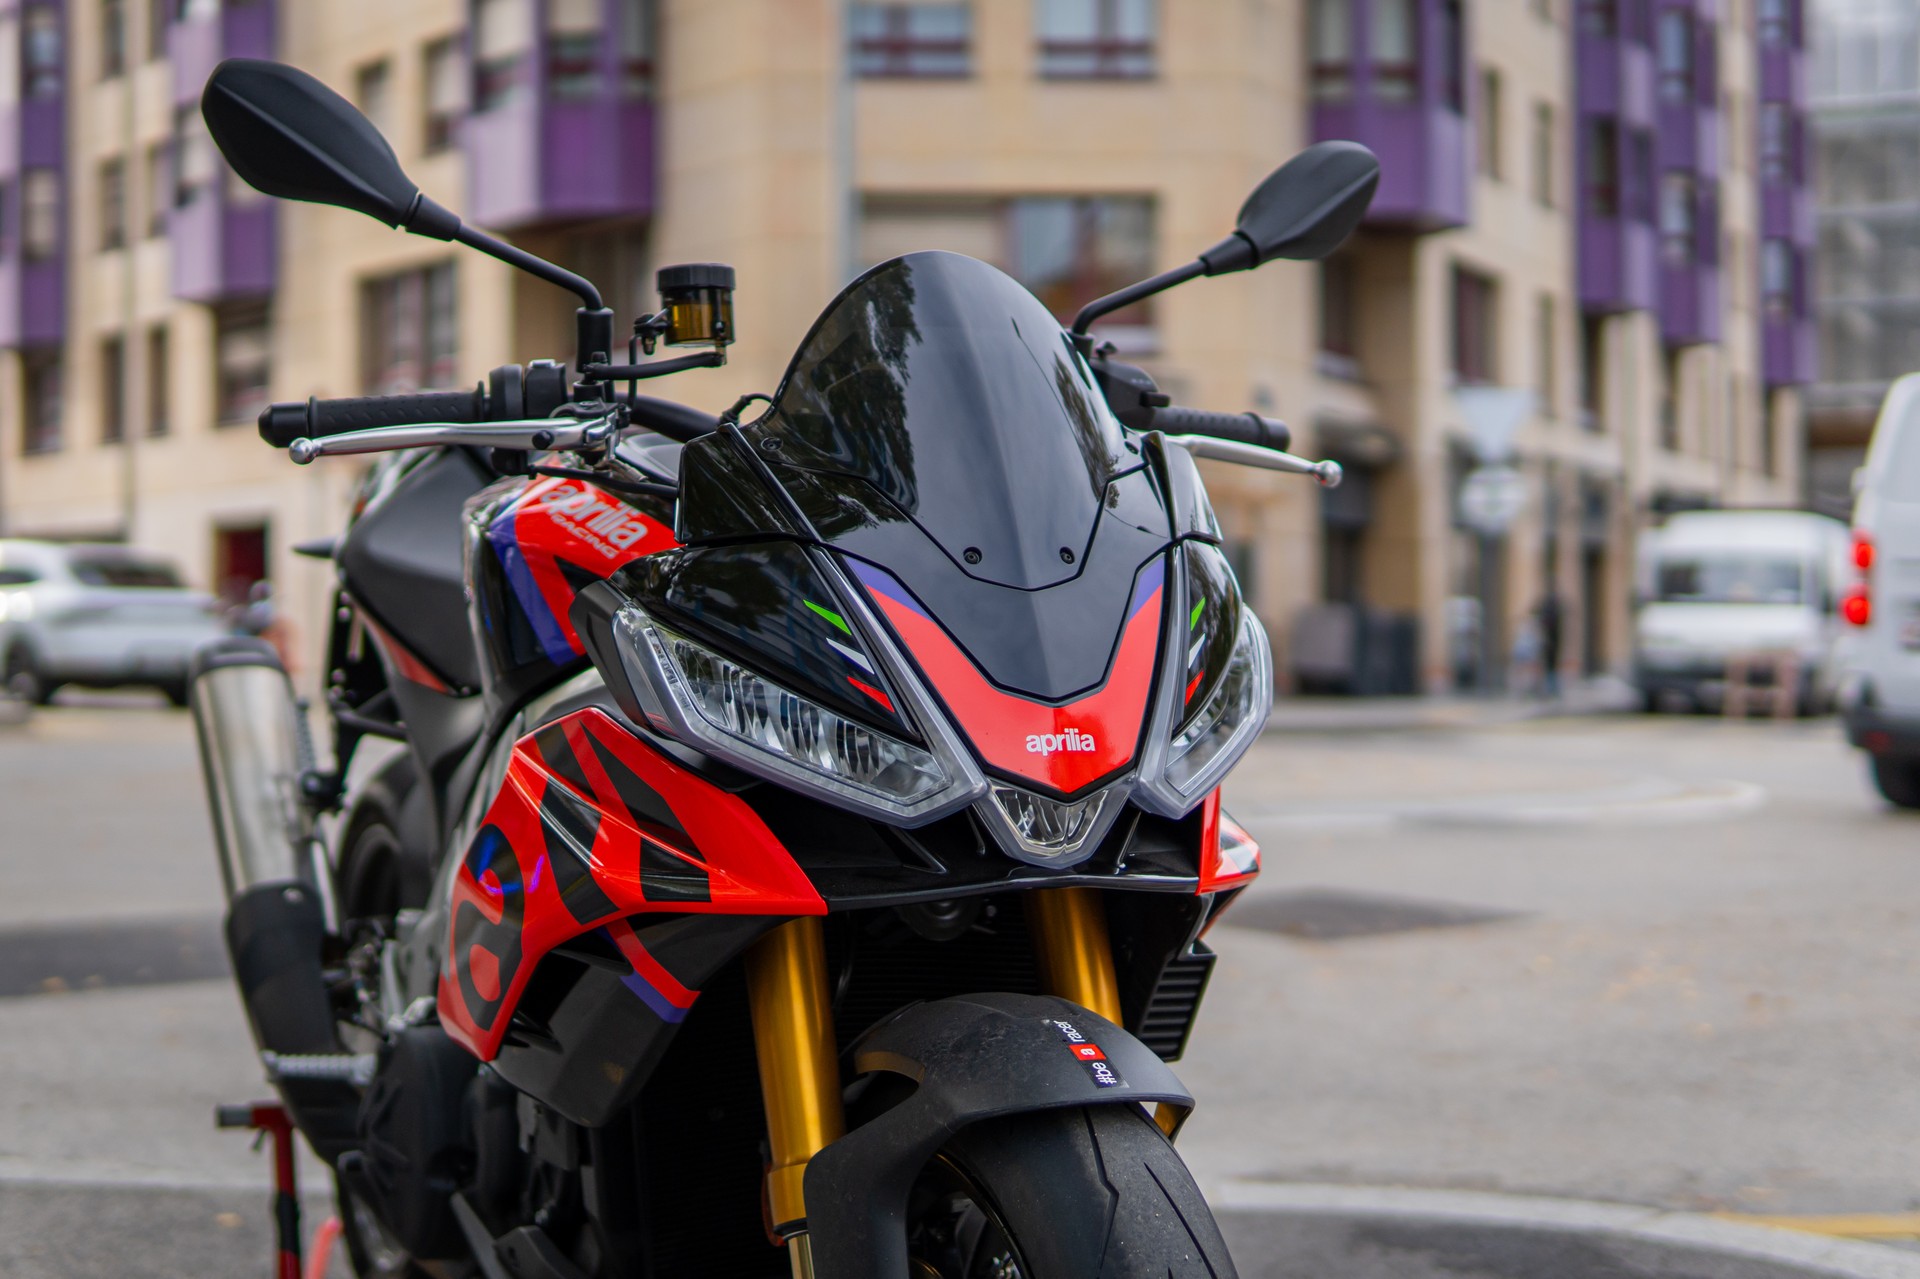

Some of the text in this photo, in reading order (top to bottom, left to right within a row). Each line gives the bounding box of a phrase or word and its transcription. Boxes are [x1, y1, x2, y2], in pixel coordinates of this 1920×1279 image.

[541, 485, 648, 550] aprilia
[551, 513, 619, 559] RACING
[1026, 727, 1095, 756] aprilia
[1092, 1062, 1117, 1084] #be
